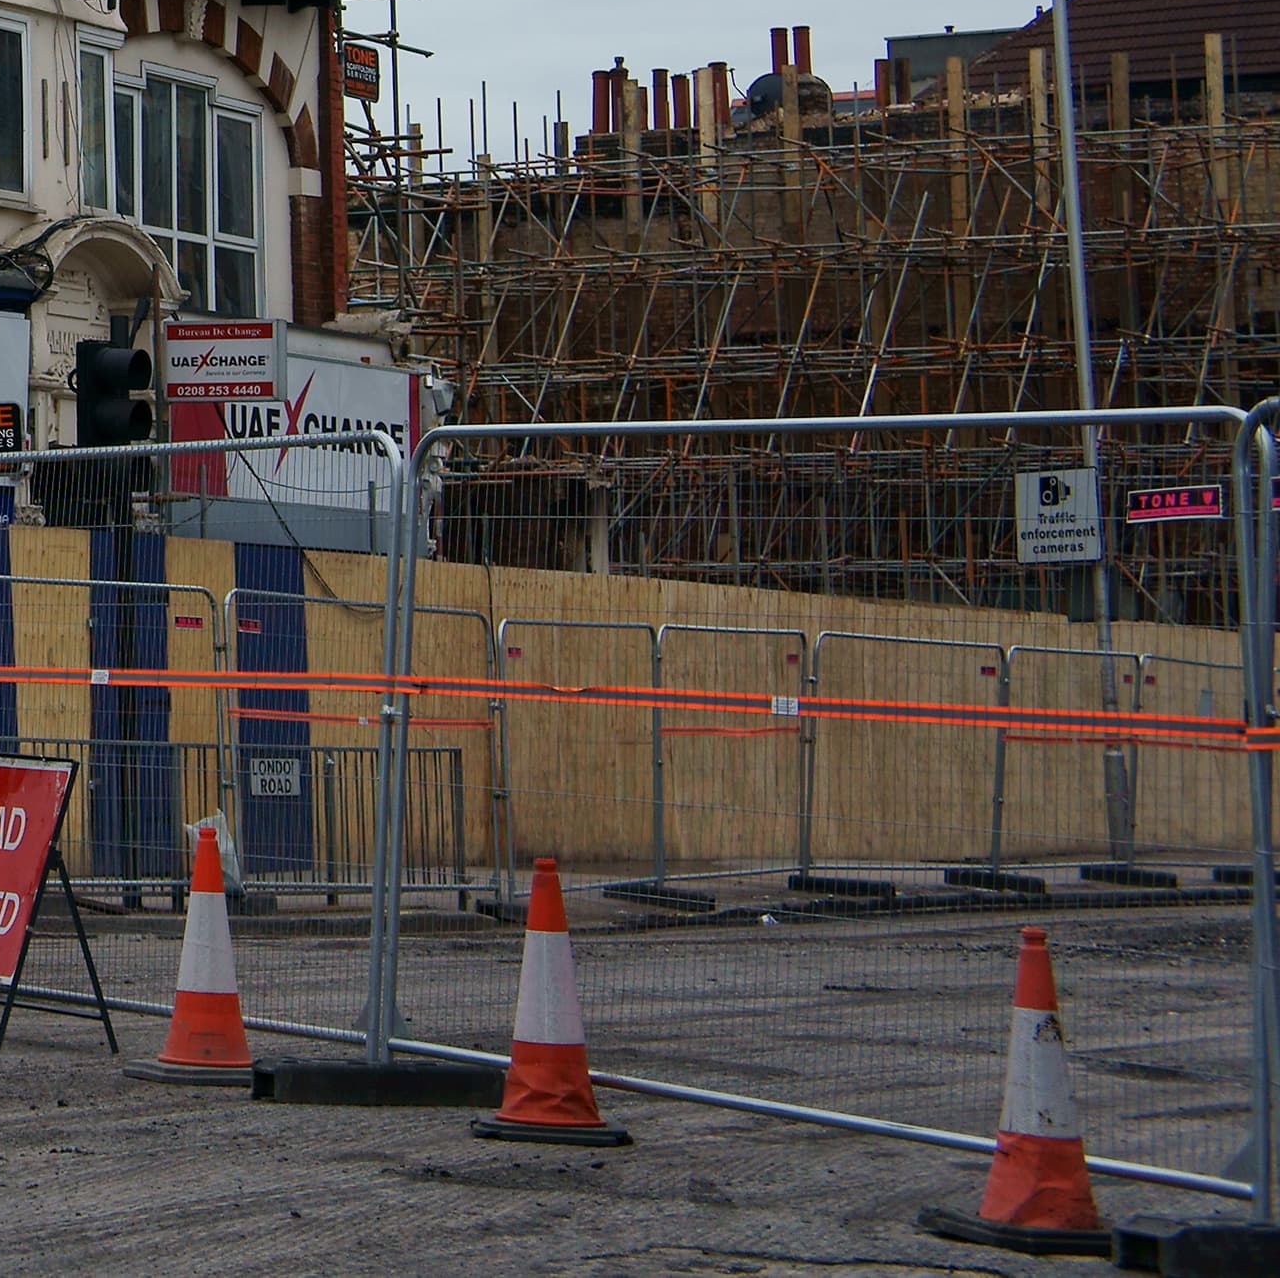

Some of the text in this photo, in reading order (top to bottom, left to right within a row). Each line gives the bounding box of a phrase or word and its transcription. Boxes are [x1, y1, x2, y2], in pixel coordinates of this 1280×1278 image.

[345, 45, 376, 67] TONE
[178, 327, 262, 337] Bureau De Change
[177, 385, 261, 396] 0208 253 4440
[1139, 492, 1189, 509] TONE
[1038, 511, 1076, 524] Traffic
[1020, 525, 1096, 540] enforcement
[1032, 542, 1084, 555] cameras
[260, 778, 292, 794] ROAD
